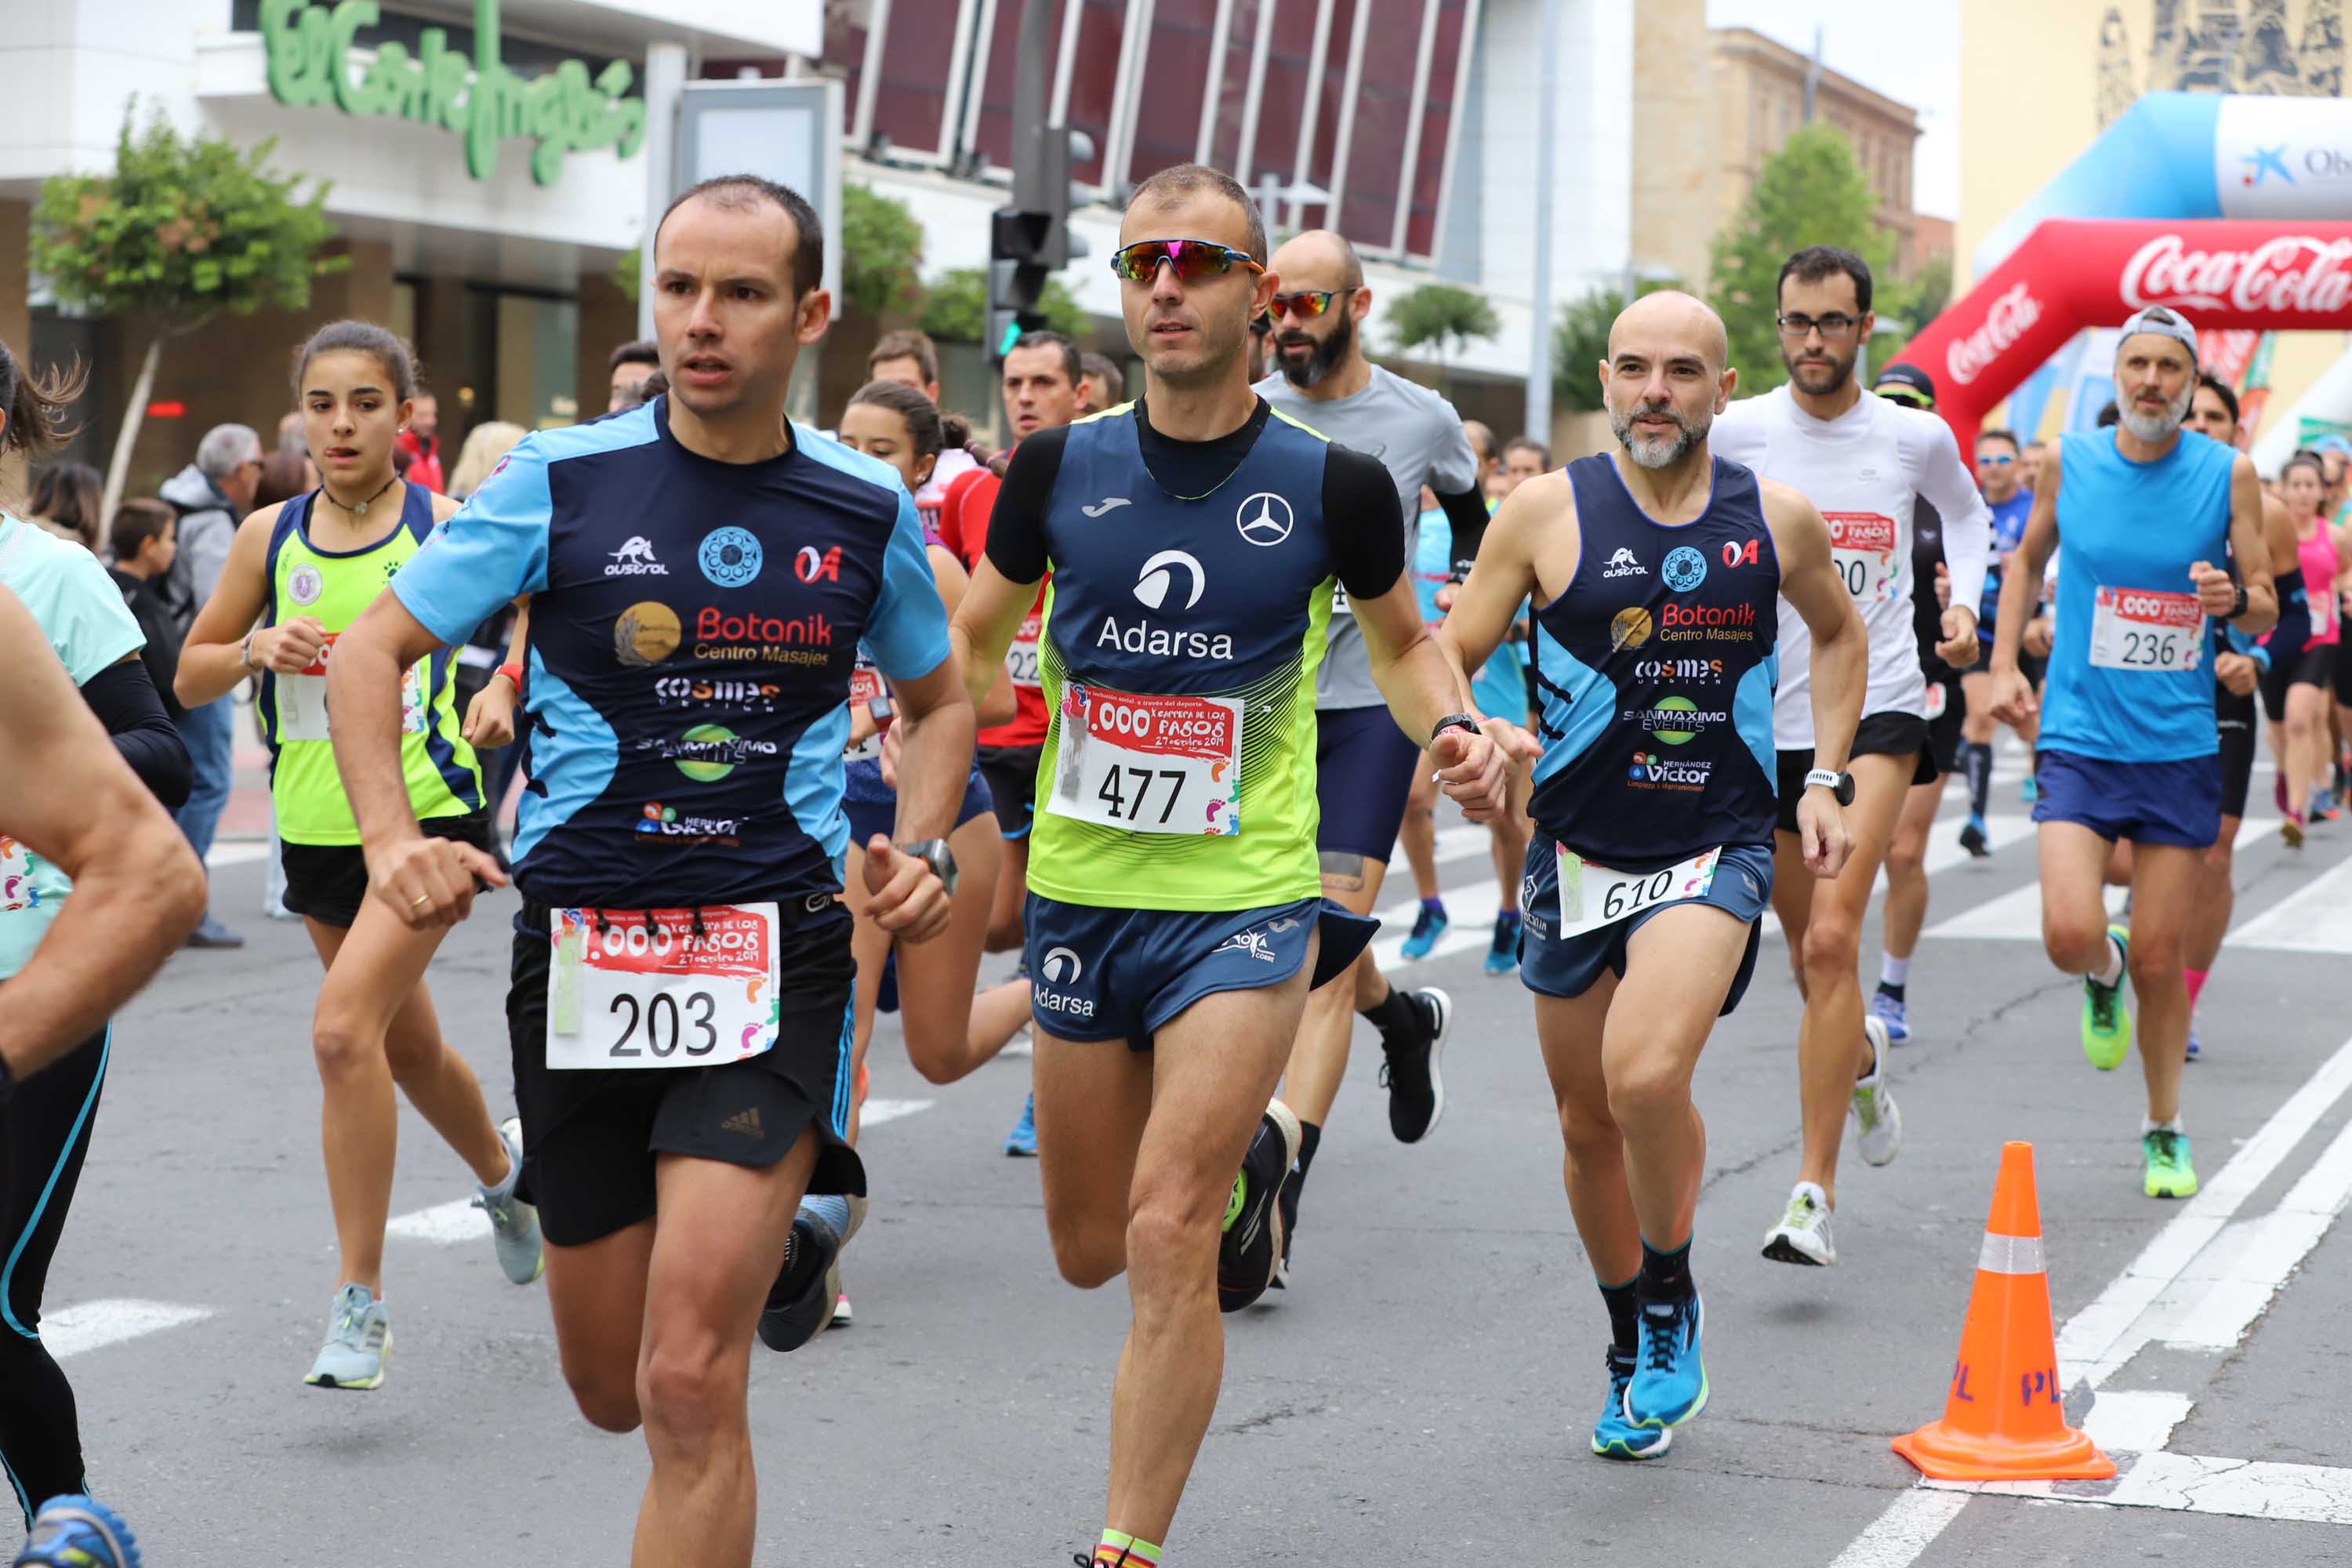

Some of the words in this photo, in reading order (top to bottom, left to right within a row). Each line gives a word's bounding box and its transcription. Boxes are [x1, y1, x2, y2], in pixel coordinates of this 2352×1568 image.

[1662, 602, 1756, 626] Botanik
[696, 607, 833, 647] Botanik
[1096, 616, 1234, 660] Adarsa
[1660, 628, 1703, 641] Centro
[1706, 628, 1753, 643] Masajes
[694, 643, 757, 661] Centro
[761, 645, 829, 667] Masajes
[2123, 632, 2177, 666] 236
[1207, 711, 1226, 720] LOS
[1623, 710, 1726, 722] SANMAXIMO
[1642, 719, 1705, 732] EVENTS
[1159, 719, 1225, 739] PASOS
[1156, 736, 1168, 746] 27
[1204, 736, 1225, 747] 2019
[1646, 764, 1710, 784] Víctor
[1664, 760, 1712, 769] HERNÁNDEZ
[1098, 764, 1187, 824] 477
[1603, 870, 1674, 920] 610
[736, 920, 759, 931] LOS
[682, 931, 759, 953] PASOS
[679, 953, 692, 965] 27
[1034, 982, 1094, 1018] Adarsa
[609, 992, 717, 1058] 203
[2021, 1367, 2061, 1407] PL
